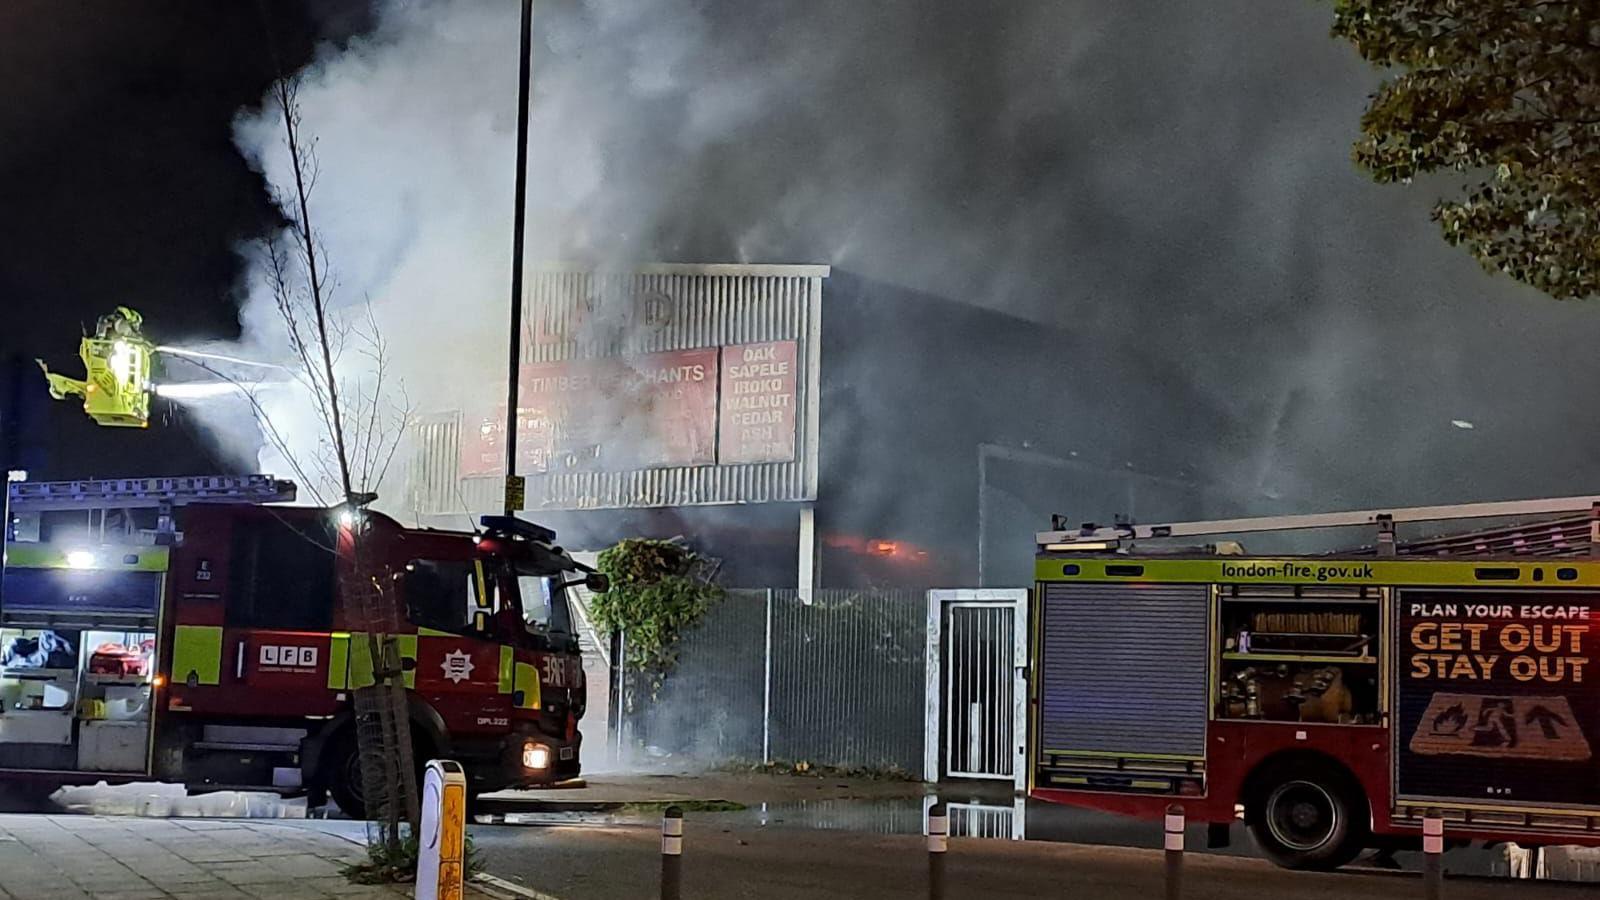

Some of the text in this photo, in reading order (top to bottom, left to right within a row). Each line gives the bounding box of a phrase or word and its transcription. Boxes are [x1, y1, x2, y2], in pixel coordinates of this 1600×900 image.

[743, 347, 776, 362] OAK
[729, 362, 789, 379] SAPELE
[531, 375, 592, 393] TIMBER
[733, 379, 783, 395] IROKO
[726, 394, 791, 411] WALNUT
[732, 410, 783, 425] CEDAR
[1222, 562, 1374, 581] london-fire.gov.uk
[1410, 603, 1590, 620] PLAN YOUR ESCAPE
[1410, 622, 1590, 653] GET OUT
[263, 647, 315, 664] LFB
[1410, 653, 1589, 682] STAY OUT
